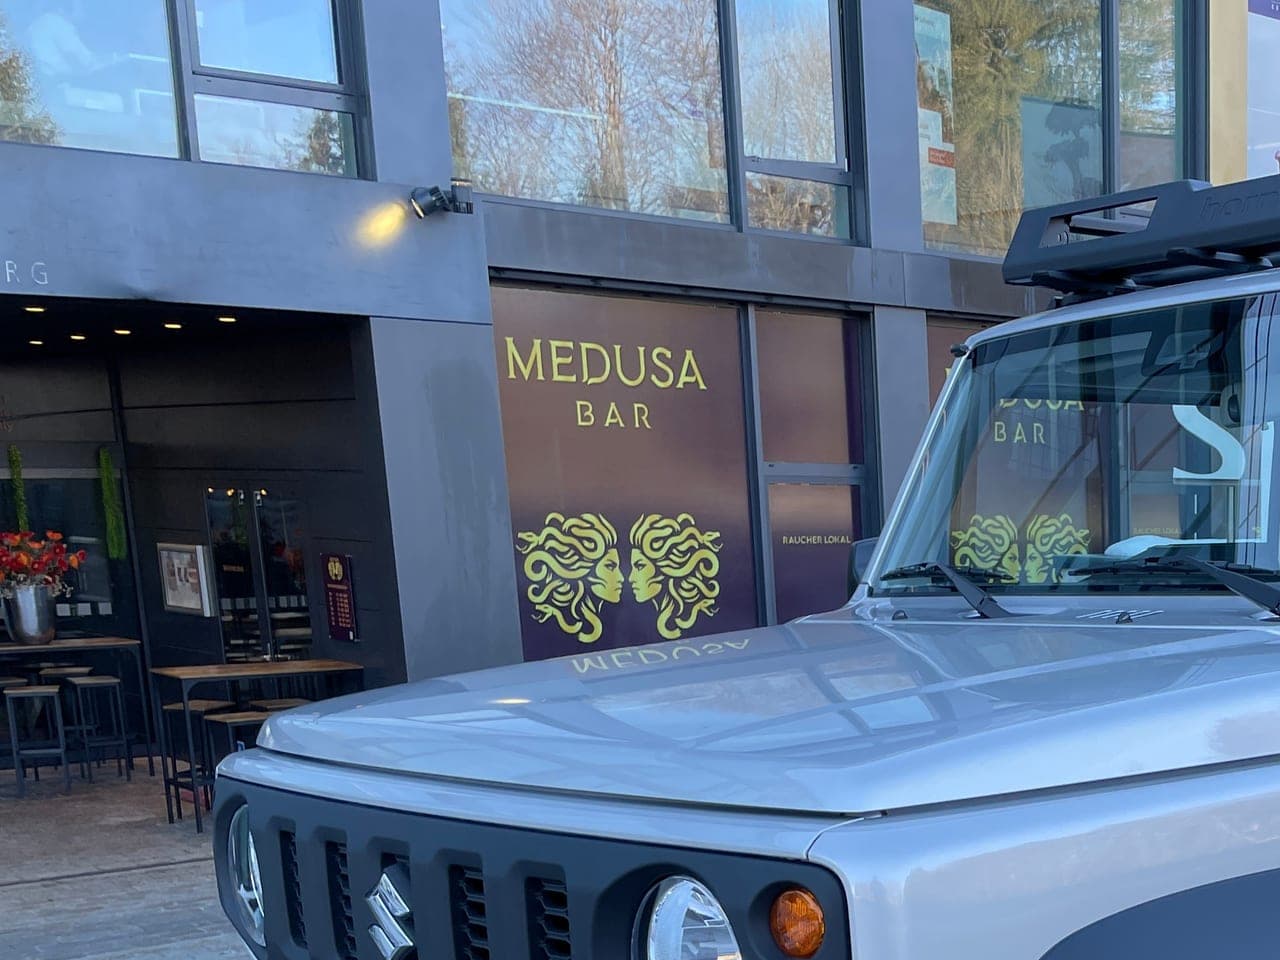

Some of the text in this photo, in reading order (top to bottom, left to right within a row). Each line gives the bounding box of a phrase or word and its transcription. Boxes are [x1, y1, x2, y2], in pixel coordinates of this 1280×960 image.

[504, 336, 708, 390] MEDUSA
[575, 400, 652, 429] BAR
[994, 421, 1046, 444] BAR
[782, 535, 852, 545] RAUCHER LOKAL
